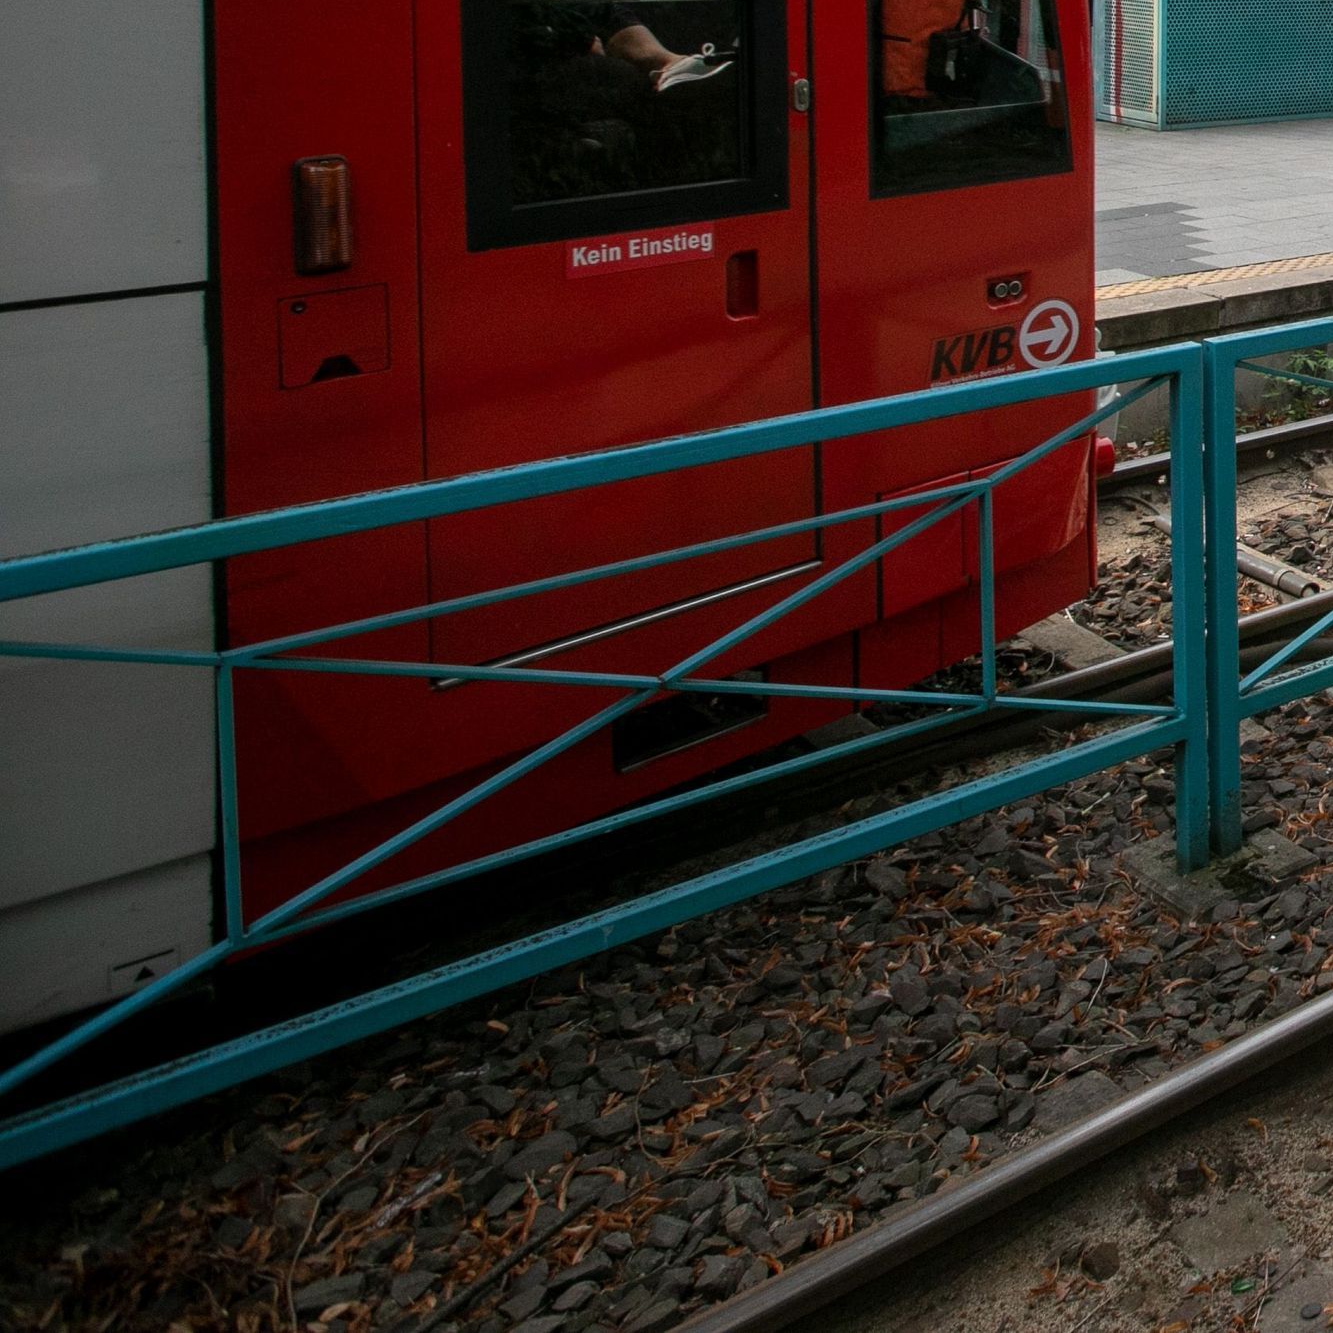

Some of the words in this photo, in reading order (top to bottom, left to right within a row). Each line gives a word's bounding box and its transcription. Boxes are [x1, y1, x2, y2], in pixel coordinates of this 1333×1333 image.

[572, 243, 622, 267] Kein
[628, 232, 713, 259] Einstieg
[930, 325, 1018, 382] KVB
